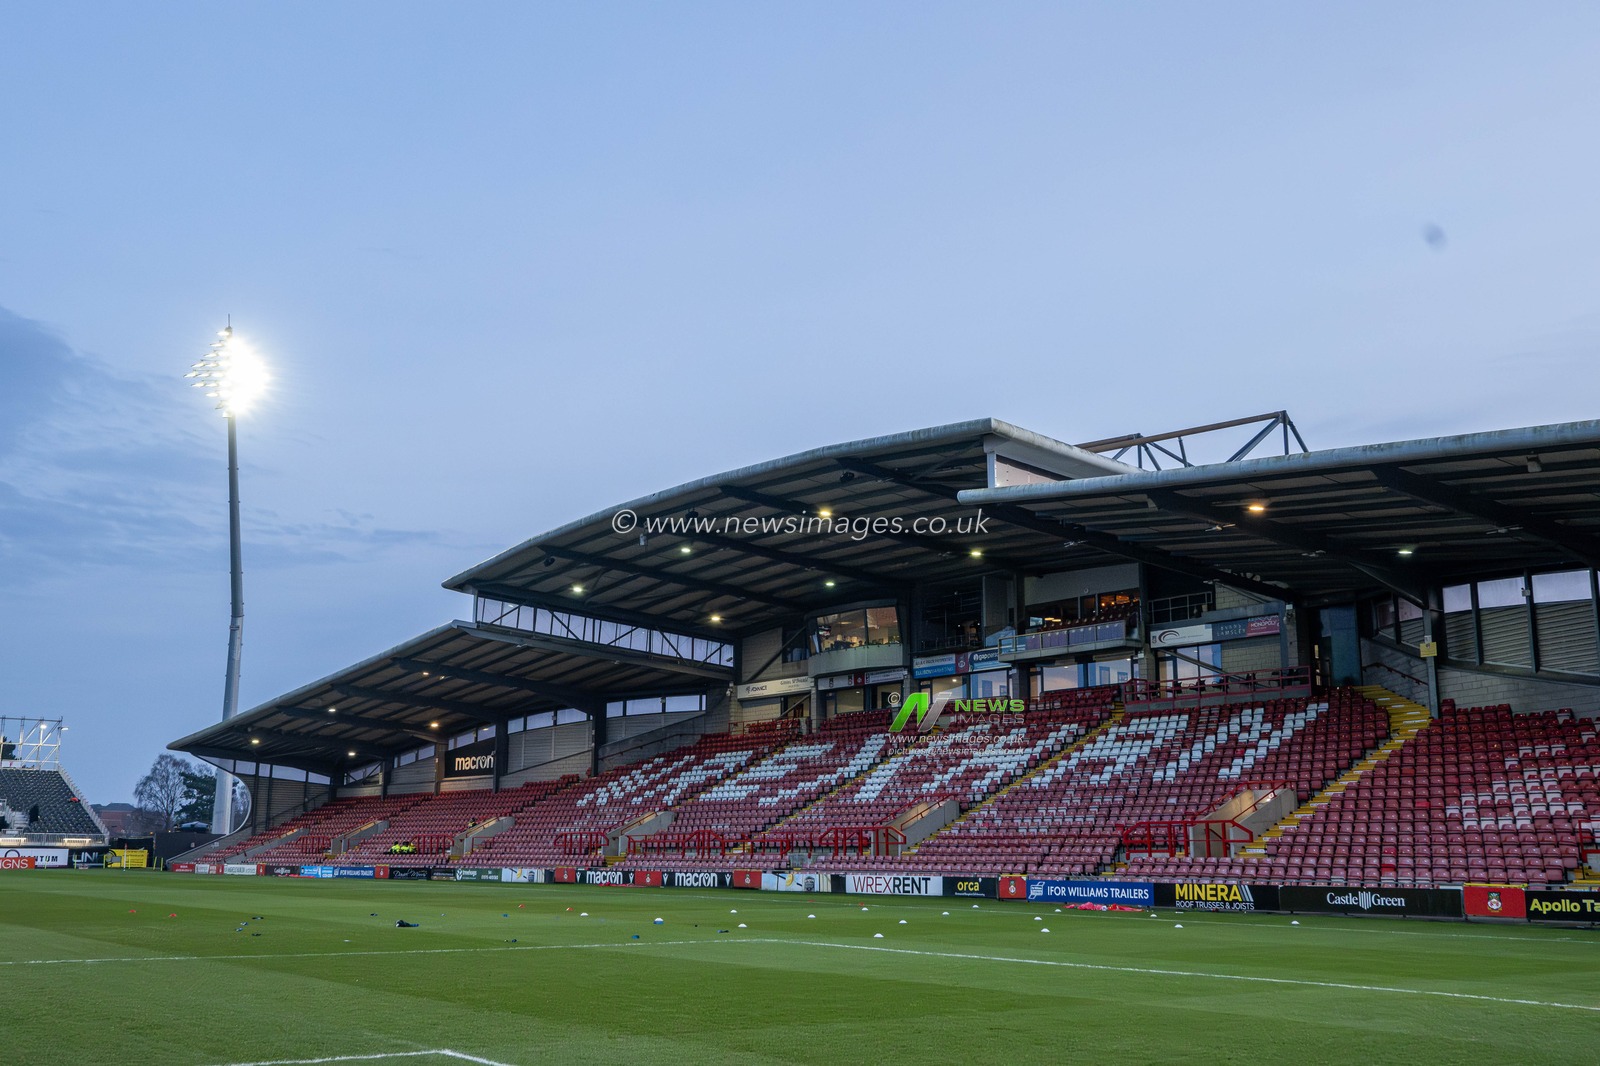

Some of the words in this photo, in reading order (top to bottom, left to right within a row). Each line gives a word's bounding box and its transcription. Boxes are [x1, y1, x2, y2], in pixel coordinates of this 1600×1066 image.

[455, 755, 494, 771] macron
[586, 871, 623, 884] macron
[674, 872, 718, 888] macron
[853, 876, 931, 895] WREXRENT
[957, 881, 979, 892] orca
[1047, 886, 1066, 896] IFOR
[1068, 887, 1108, 898] WILLIAMS
[1110, 888, 1149, 899] TRAILERS
[1175, 883, 1242, 901] MINERA
[1196, 901, 1224, 909] TRUSSES
[1326, 892, 1359, 905] Castle
[1371, 893, 1406, 907] Green
[1529, 898, 1581, 914] Apollo
